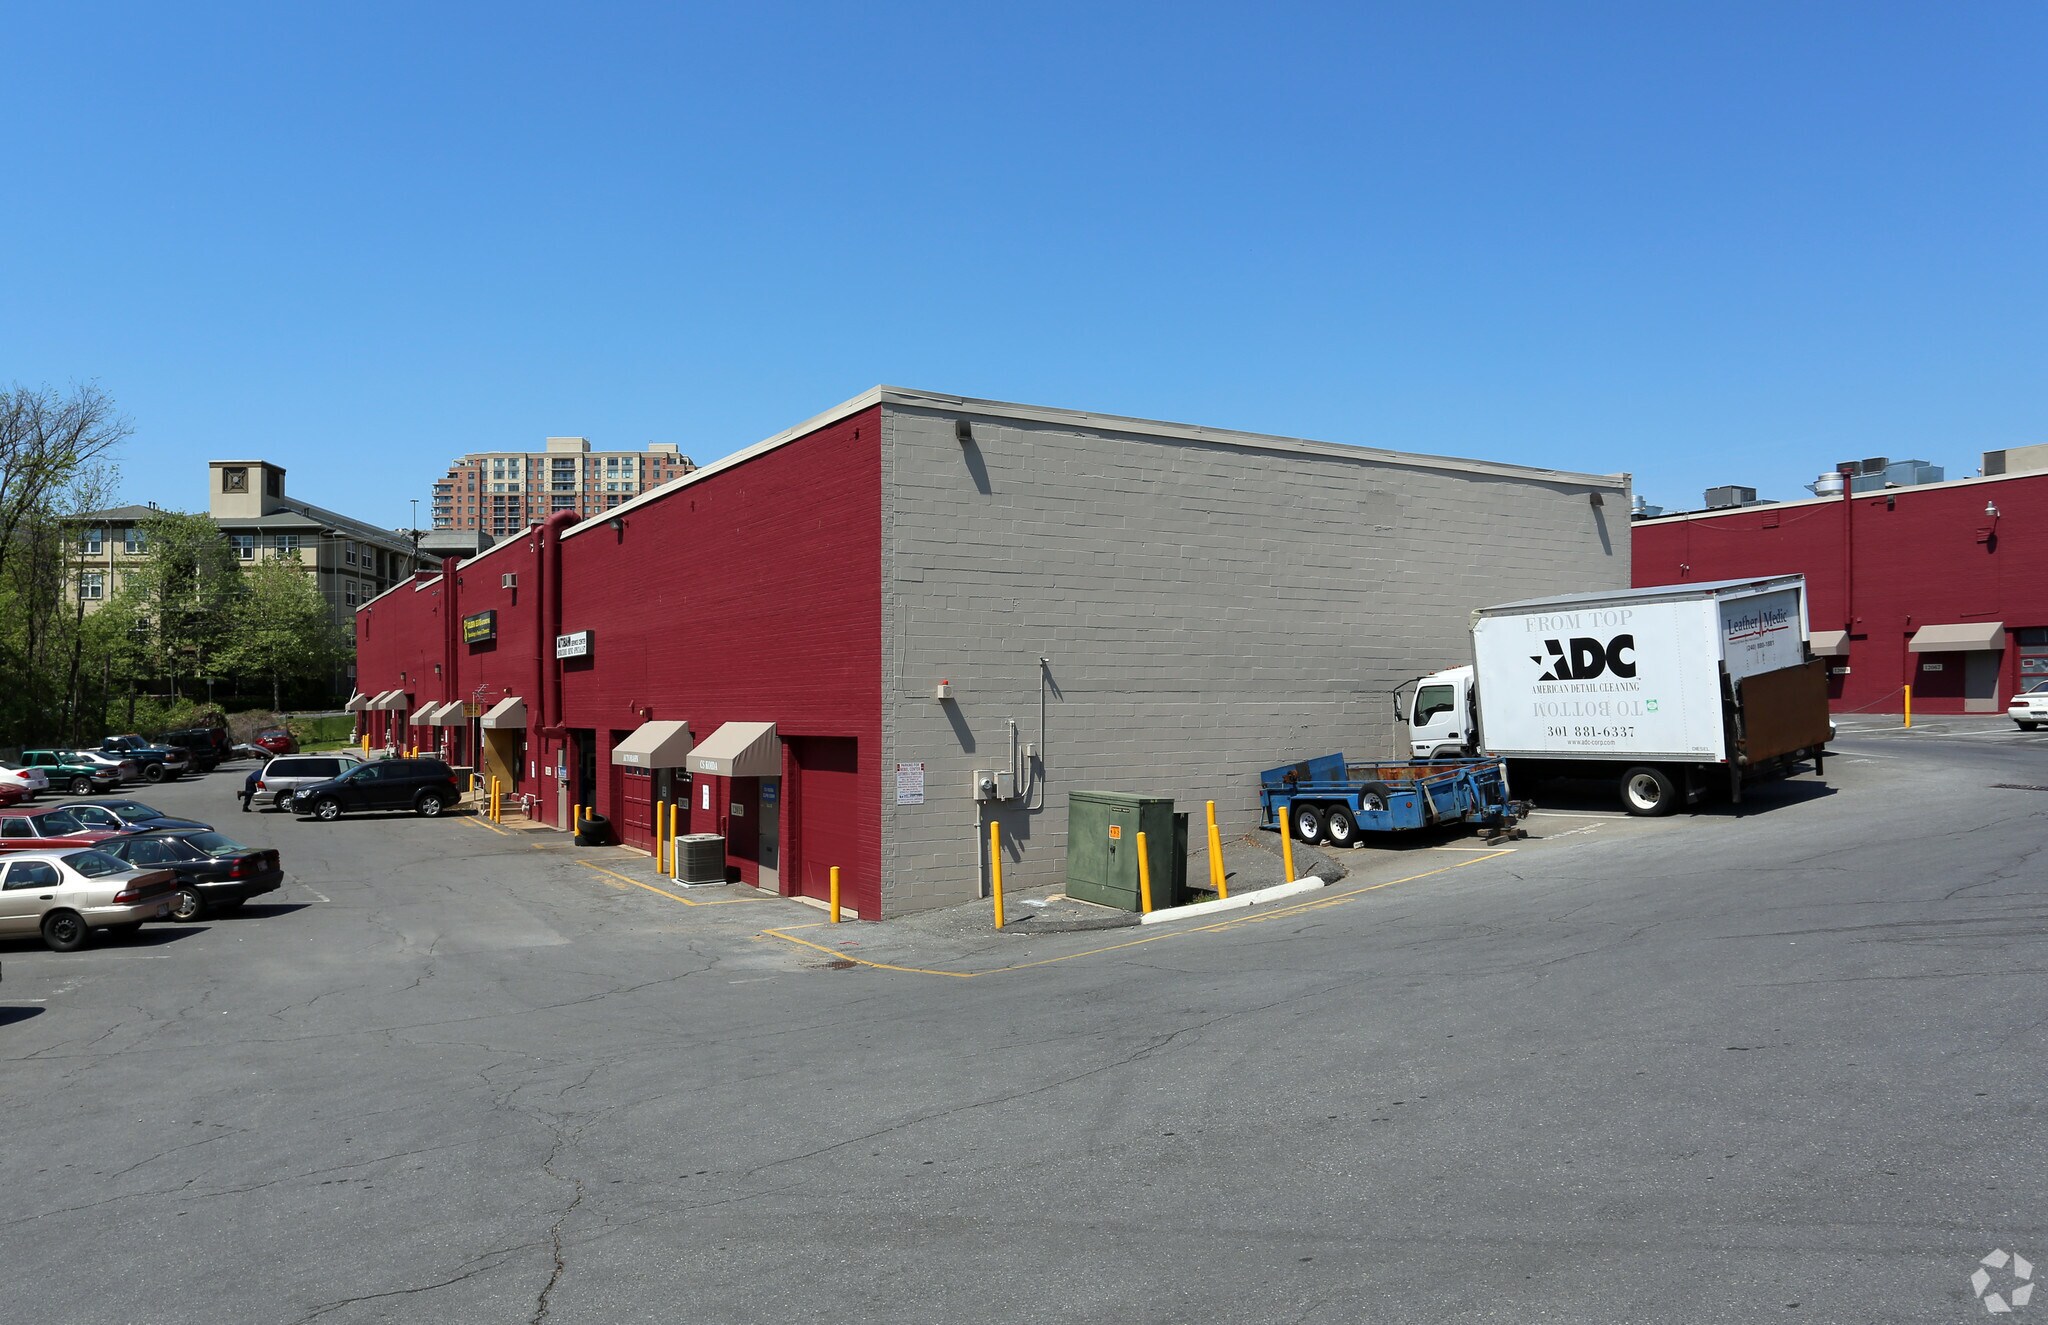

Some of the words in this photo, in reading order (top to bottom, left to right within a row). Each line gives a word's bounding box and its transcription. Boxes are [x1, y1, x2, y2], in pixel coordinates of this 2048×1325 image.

[1525, 613, 1582, 632] FROM
[1588, 609, 1633, 629] TOP
[1727, 615, 1758, 635] Leather
[1763, 608, 1788, 628] Medic
[1529, 634, 1638, 682] ADC
[1531, 683, 1569, 695] AMERICAN
[1571, 683, 1598, 694] DETAIL
[1599, 681, 1640, 693] CLEANING
[1533, 701, 1610, 717] BOTTOM
[1616, 700, 1643, 716] TO
[1547, 726, 1567, 737] 301
[1574, 725, 1635, 738] 881-6337
[1567, 738, 1616, 746] www.adc-corp.com
